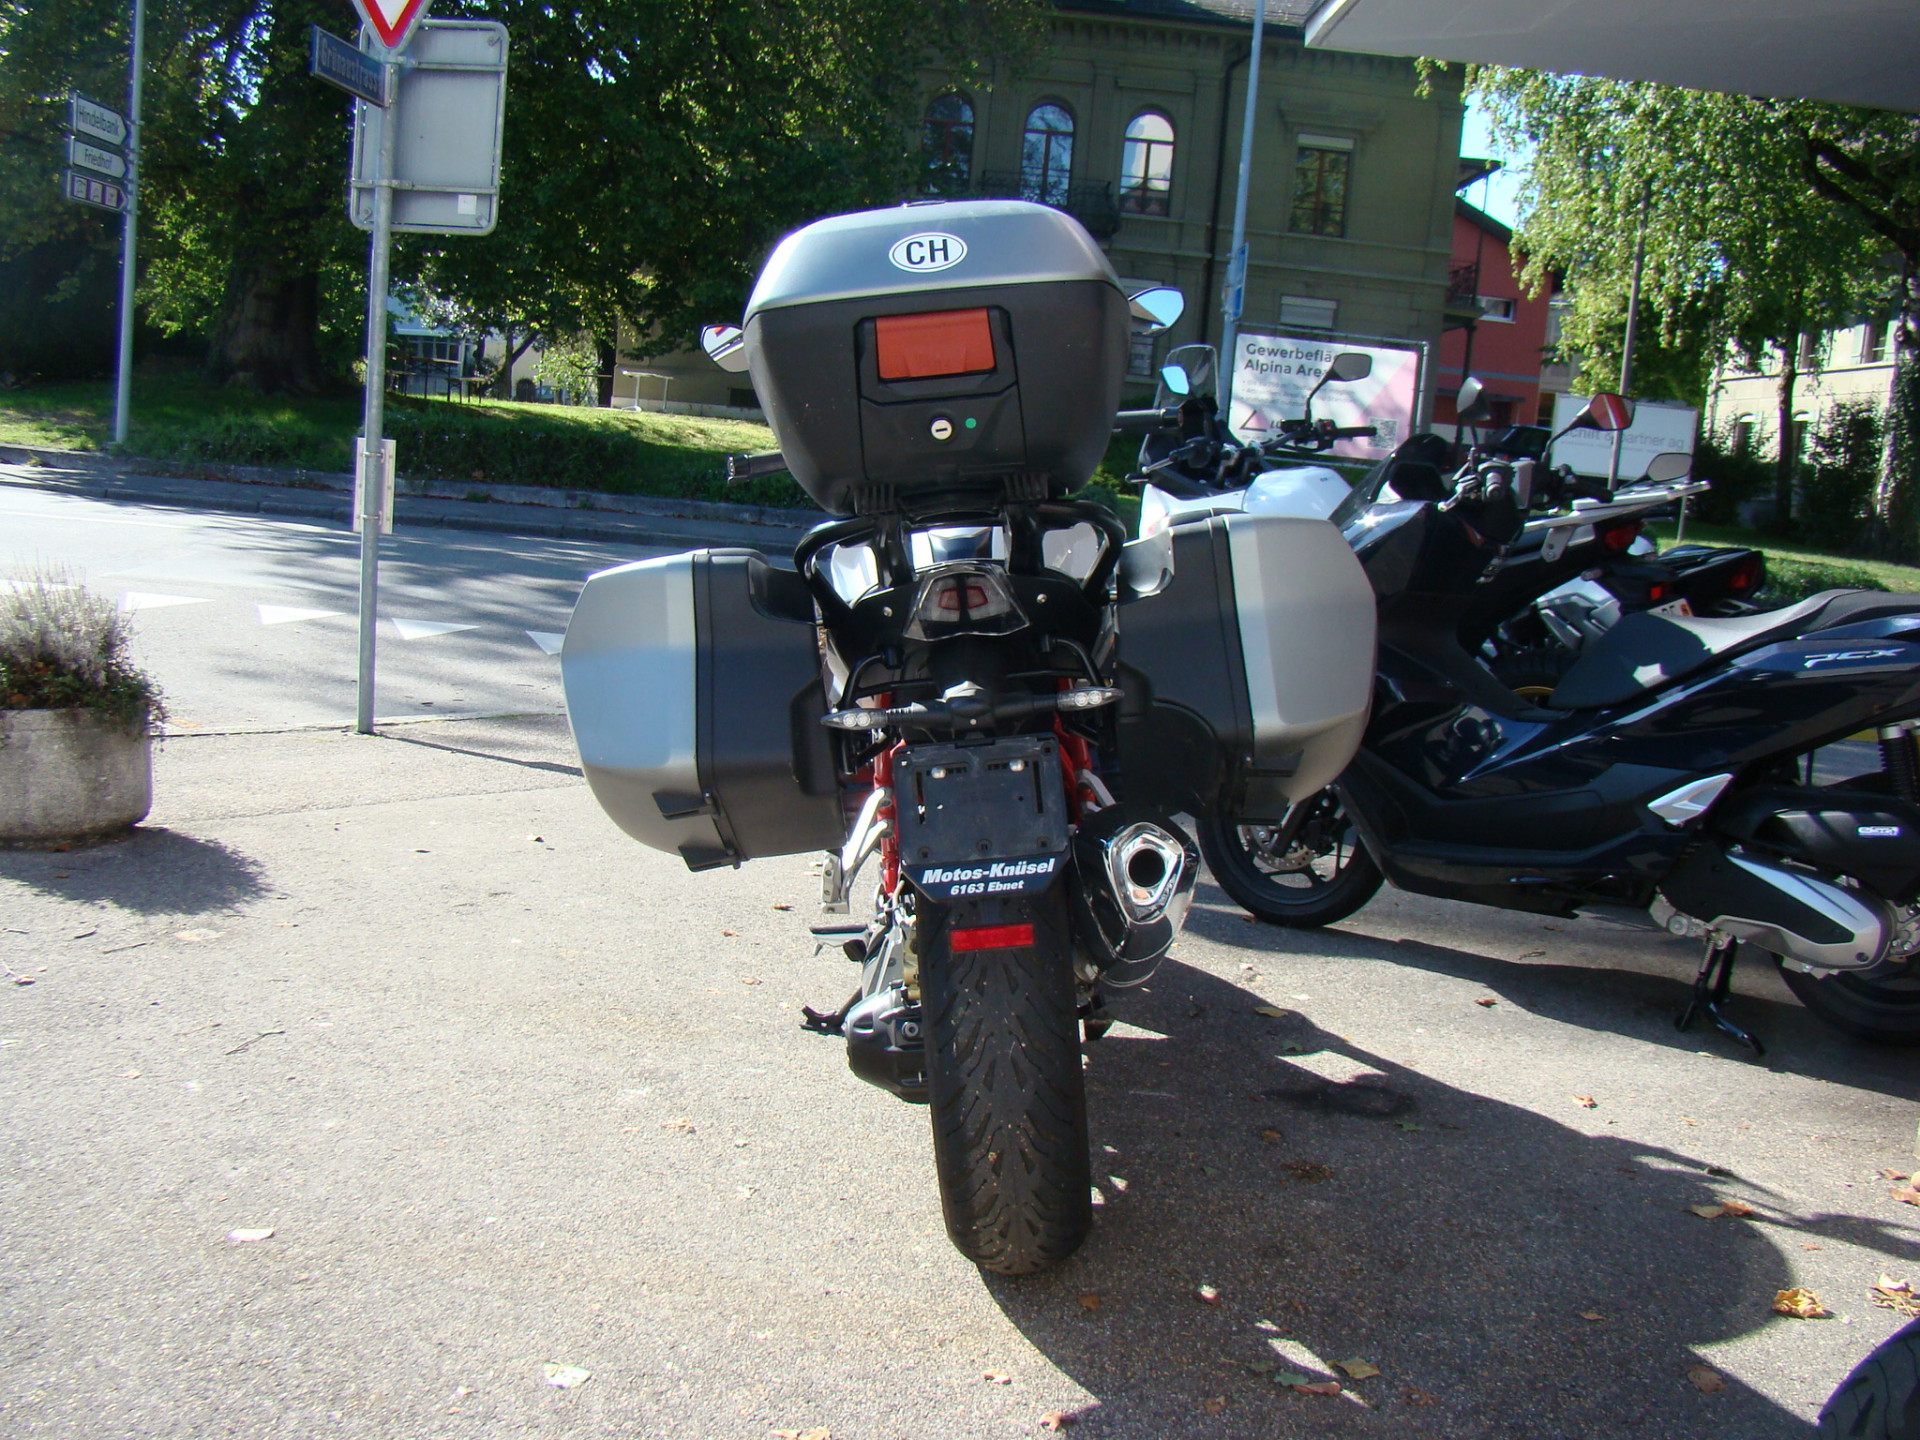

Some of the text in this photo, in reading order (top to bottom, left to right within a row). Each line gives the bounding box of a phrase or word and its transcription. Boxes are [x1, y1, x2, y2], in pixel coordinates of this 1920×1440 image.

[78, 104, 119, 136] Hindelbank
[84, 148, 113, 171] Friedhof
[906, 239, 949, 265] CH
[1246, 343, 1337, 363] Gewerbeflä
[1244, 359, 1292, 374] Alpina
[1621, 432, 1666, 447] artner
[1668, 437, 1685, 451] ag
[1804, 648, 1906, 668] PCX
[922, 858, 1056, 884] Motos-Knüsel
[950, 880, 1025, 896] 6163 Ebnet
